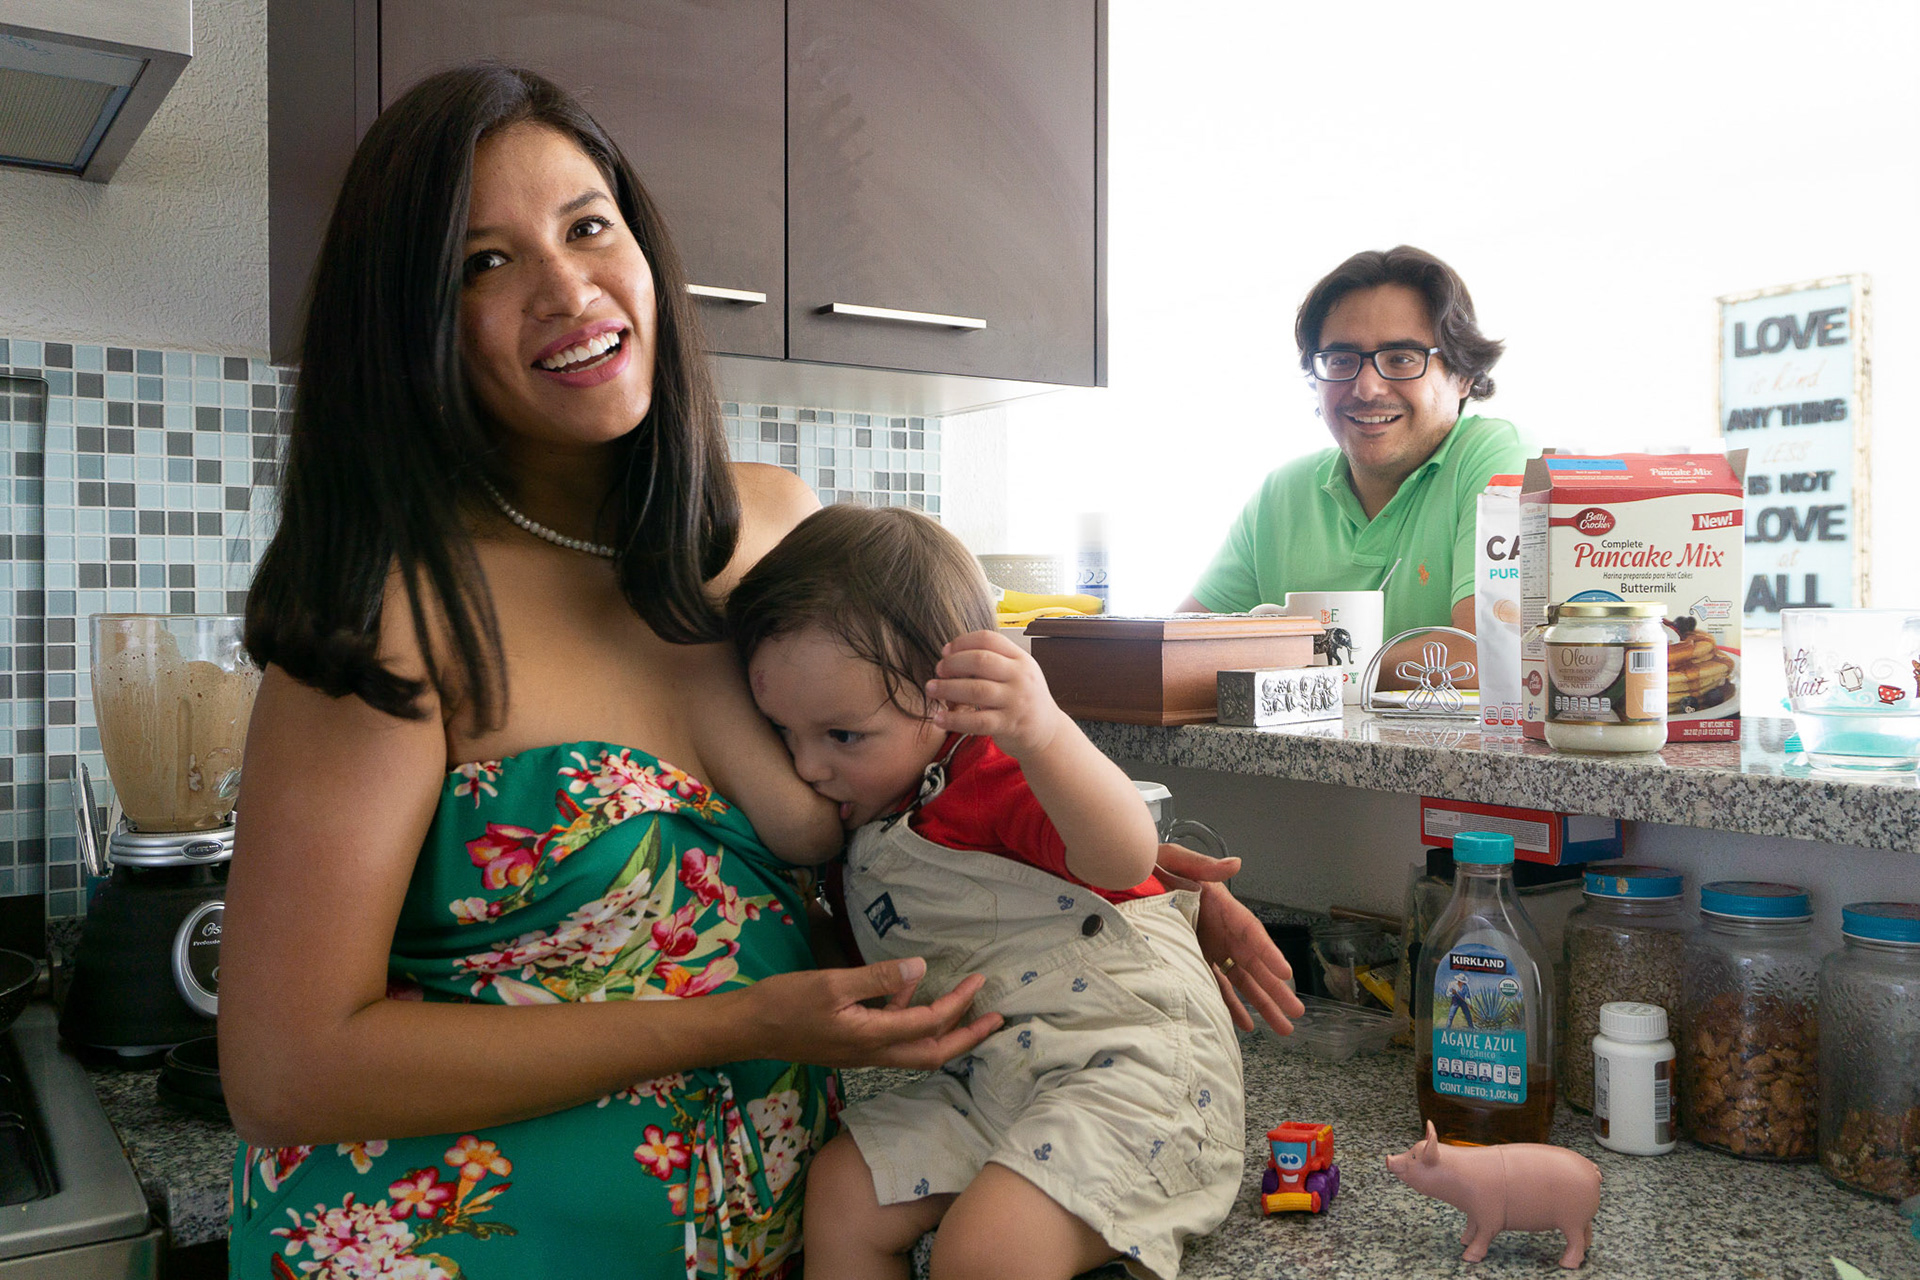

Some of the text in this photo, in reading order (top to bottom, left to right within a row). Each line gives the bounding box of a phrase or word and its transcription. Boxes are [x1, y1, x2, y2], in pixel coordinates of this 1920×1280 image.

[1734, 306, 1848, 358] LOVE
[1727, 398, 1848, 432] ANYTHING
[1649, 467, 1714, 476] Pancake Mix
[1779, 470, 1836, 494] NOT
[1579, 519, 1611, 530] Crocker
[1586, 511, 1608, 523] Betty
[1698, 512, 1734, 528] New!
[1601, 539, 1643, 551] Complete
[1573, 542, 1725, 568] Pancake Mix
[1603, 571, 1623, 580] Harina
[1653, 573, 1666, 581] para
[1667, 571, 1677, 579] Hot
[1677, 571, 1693, 579] Cakes
[1620, 582, 1677, 594] Buttermilk
[1743, 573, 1834, 613] ALL
[1320, 608, 1339, 624] BE
[1452, 955, 1505, 969] KIRKLAND
[1440, 1030, 1518, 1054] AGAVE AZUL
[1440, 1081, 1464, 1095] CONT.
[1464, 1084, 1489, 1098] NETO:
[1507, 1089, 1519, 1103] kg
